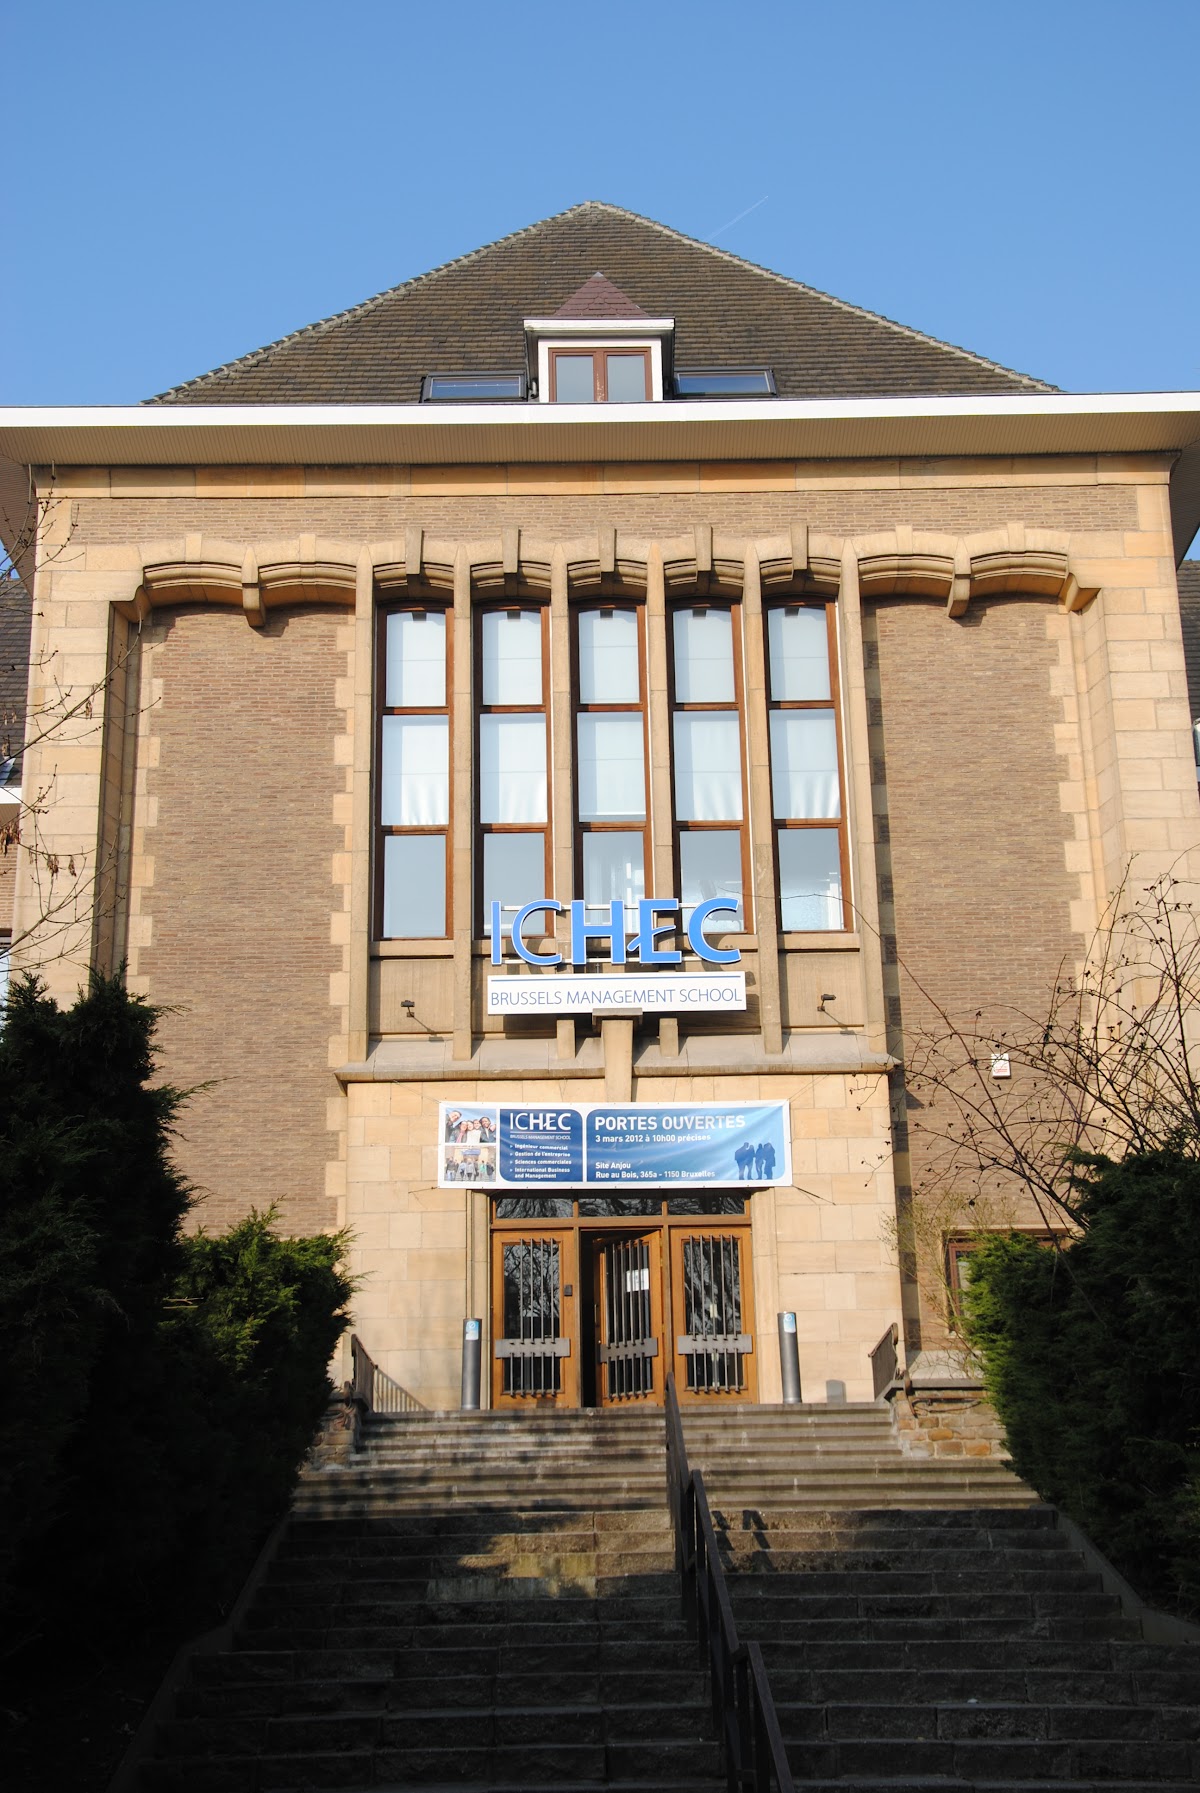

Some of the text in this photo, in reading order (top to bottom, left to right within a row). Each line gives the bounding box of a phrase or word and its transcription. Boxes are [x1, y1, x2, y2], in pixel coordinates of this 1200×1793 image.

[490, 897, 742, 966] ICHEC
[491, 988, 743, 1006] BRUSSELS MANAGEMENT SCHOOL
[510, 1112, 571, 1131] ICHEC
[595, 1114, 746, 1131] PORTES OUVERTES
[595, 1135, 601, 1143] 3
[625, 1134, 644, 1142] 2012
[645, 1134, 650, 1142] à
[652, 1134, 676, 1142] 10h00
[677, 1133, 711, 1143] précises
[595, 1171, 609, 1179] Rue
[621, 1171, 639, 1179] Bois,
[681, 1170, 715, 1178] Bruxelles
[611, 1162, 631, 1170] Anjou
